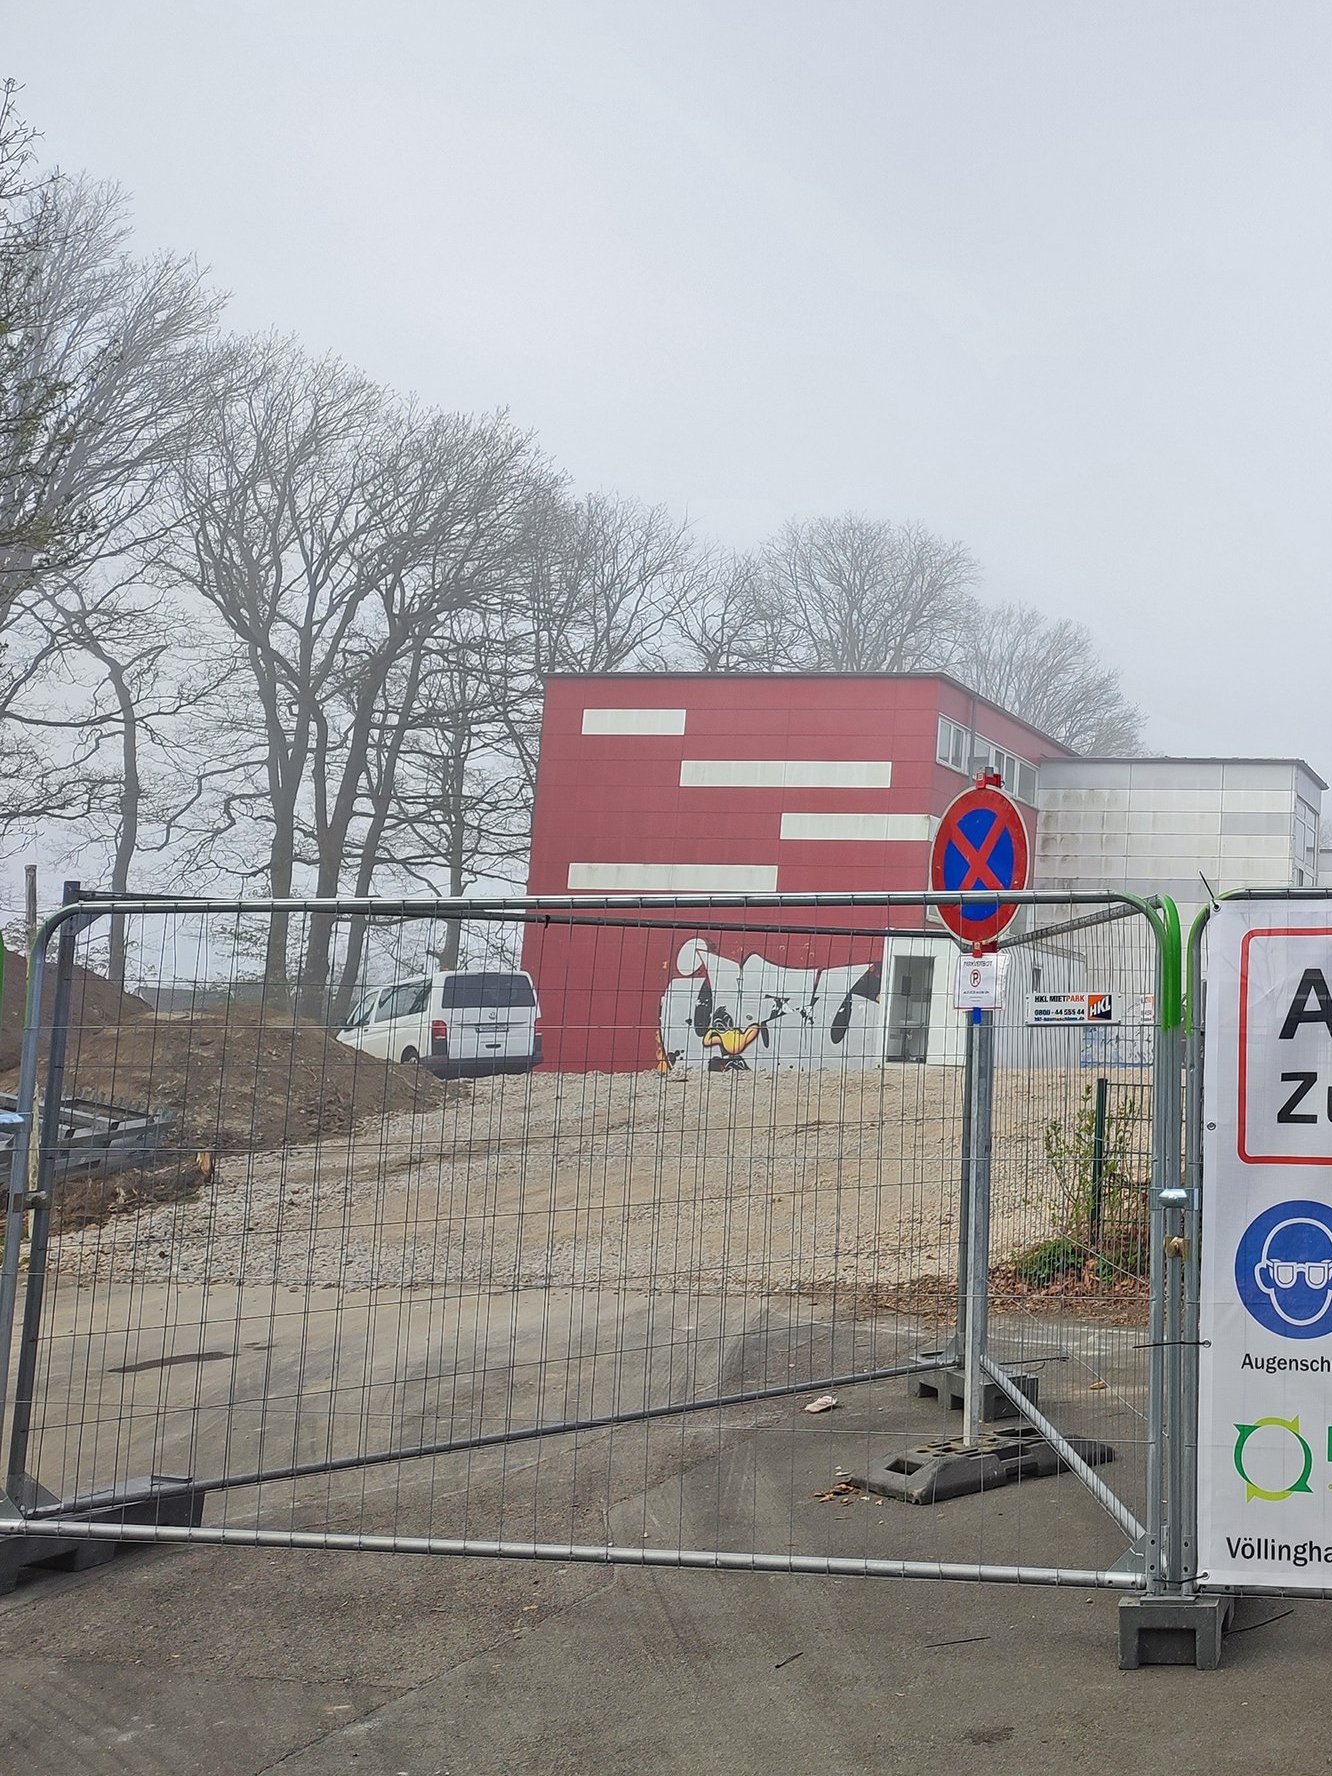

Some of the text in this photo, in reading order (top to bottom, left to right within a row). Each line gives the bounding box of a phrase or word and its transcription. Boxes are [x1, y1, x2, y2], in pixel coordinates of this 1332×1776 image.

[1034, 994, 1085, 1003] HKL MIETPARK
[1089, 995, 1111, 1017] HKL
